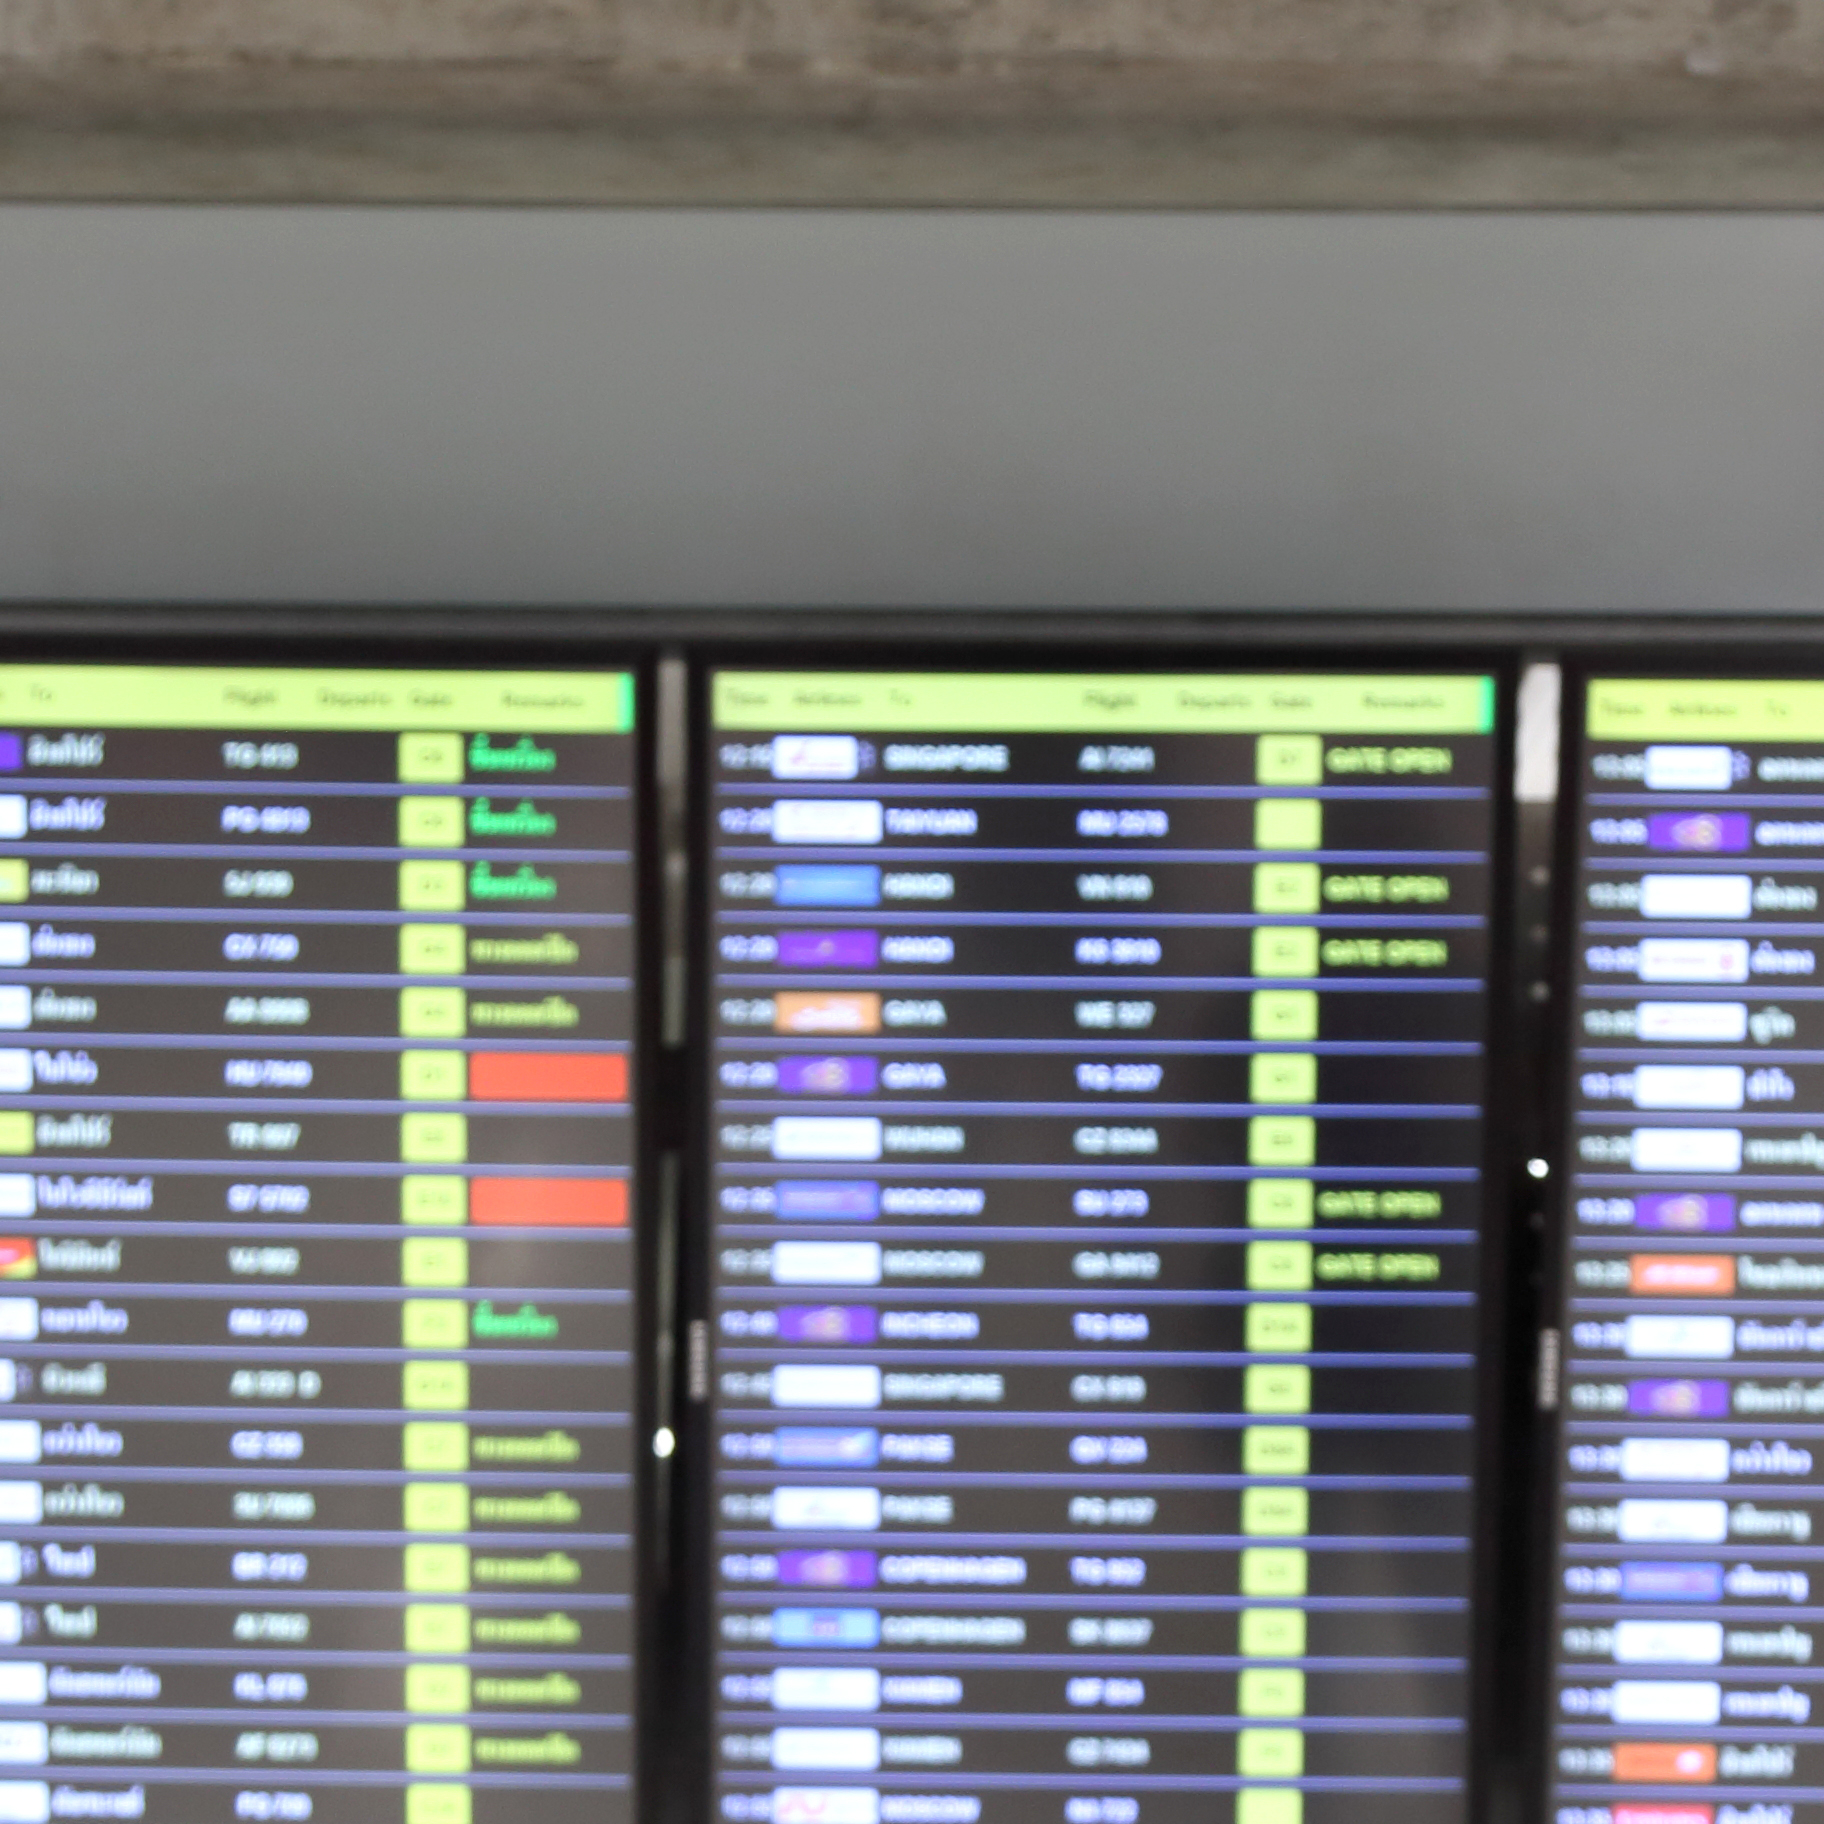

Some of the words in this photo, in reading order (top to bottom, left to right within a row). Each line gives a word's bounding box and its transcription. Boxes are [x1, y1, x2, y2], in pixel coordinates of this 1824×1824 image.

[1327, 747, 1391, 773] GATE
[1392, 747, 1451, 773] OPEN
[1323, 876, 1387, 902] GATE
[1388, 876, 1448, 901] OPEN
[1321, 940, 1385, 965] GATE
[1387, 940, 1447, 965] OPEN
[1318, 1191, 1381, 1216] GATE
[1382, 1192, 1441, 1217] OPEN
[1316, 1254, 1380, 1279] GATE
[1381, 1254, 1439, 1279] OPEN
